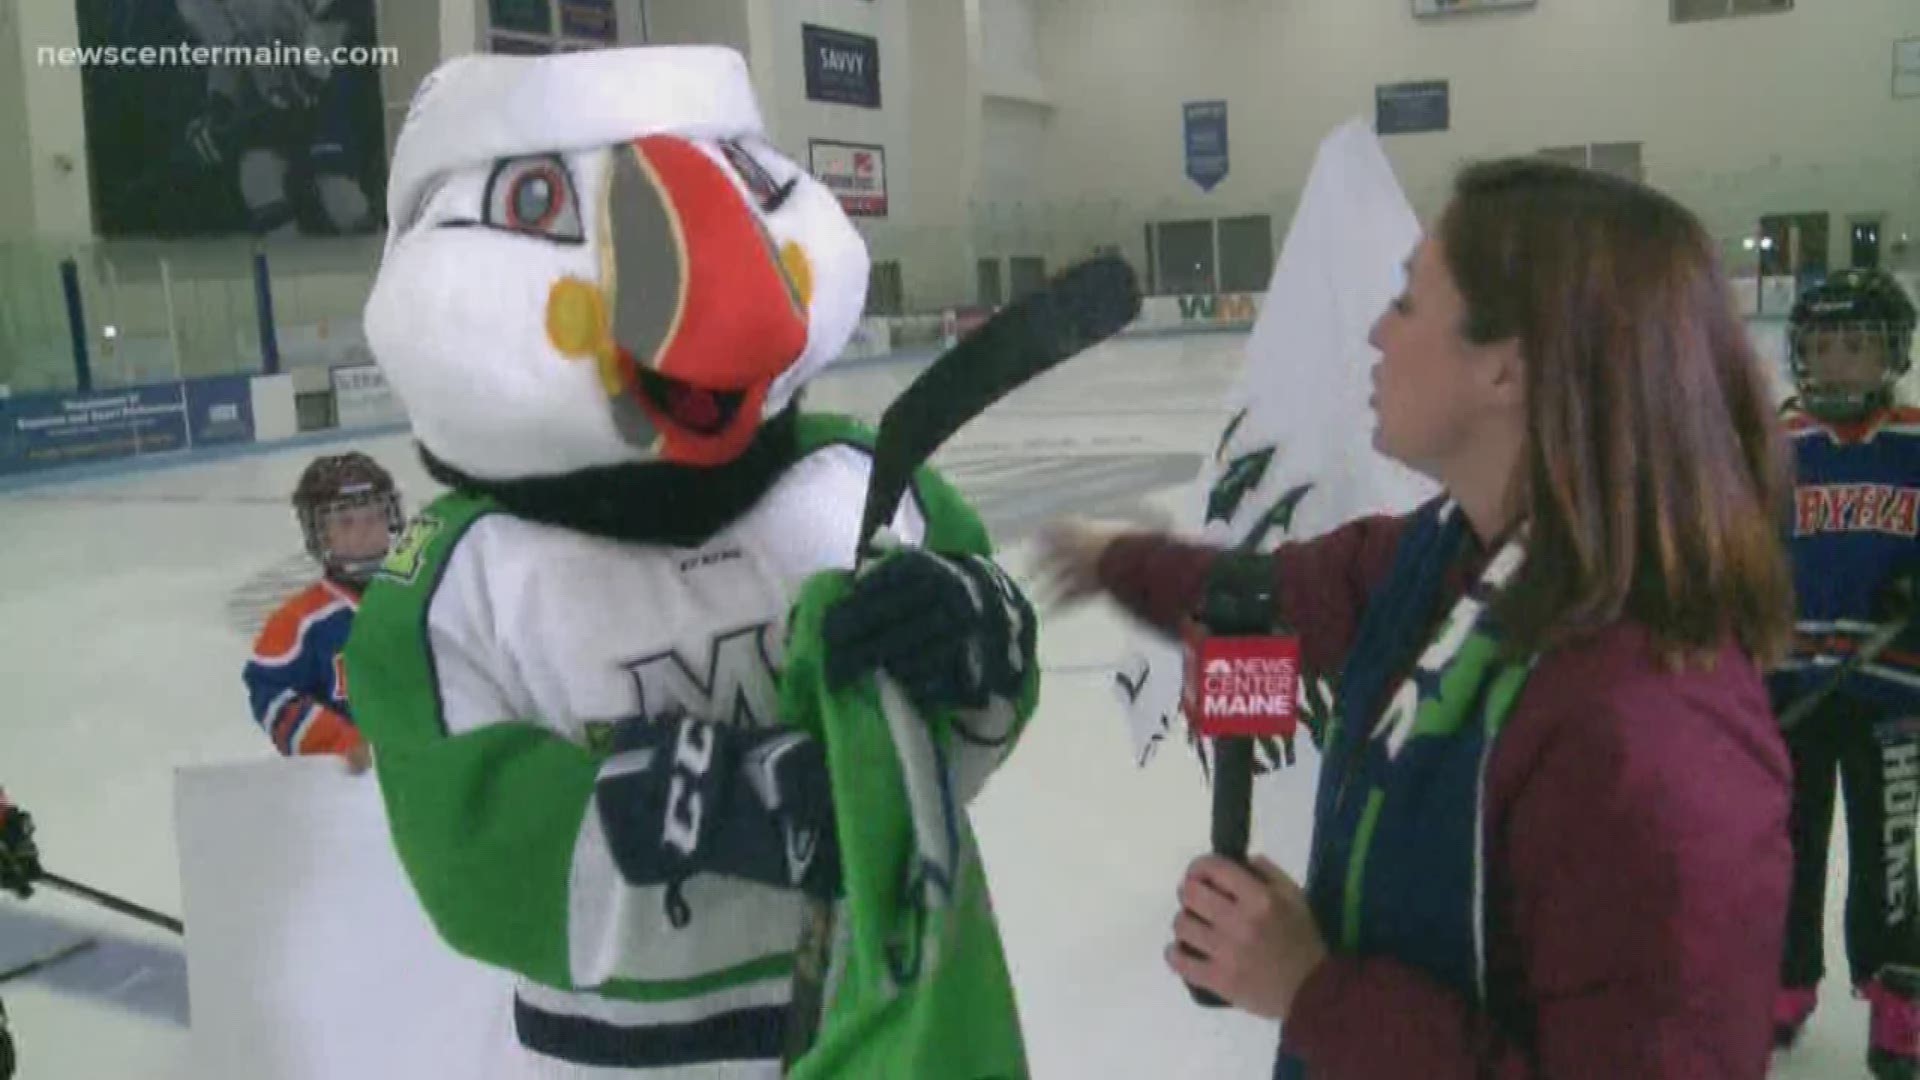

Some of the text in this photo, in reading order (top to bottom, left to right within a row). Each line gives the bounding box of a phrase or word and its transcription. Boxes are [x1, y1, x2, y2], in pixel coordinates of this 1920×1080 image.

[820, 47, 864, 76] SAVVY
[1233, 658, 1294, 674] NEWS
[1203, 676, 1292, 695] CENTER
[1203, 694, 1291, 717] MAINE
